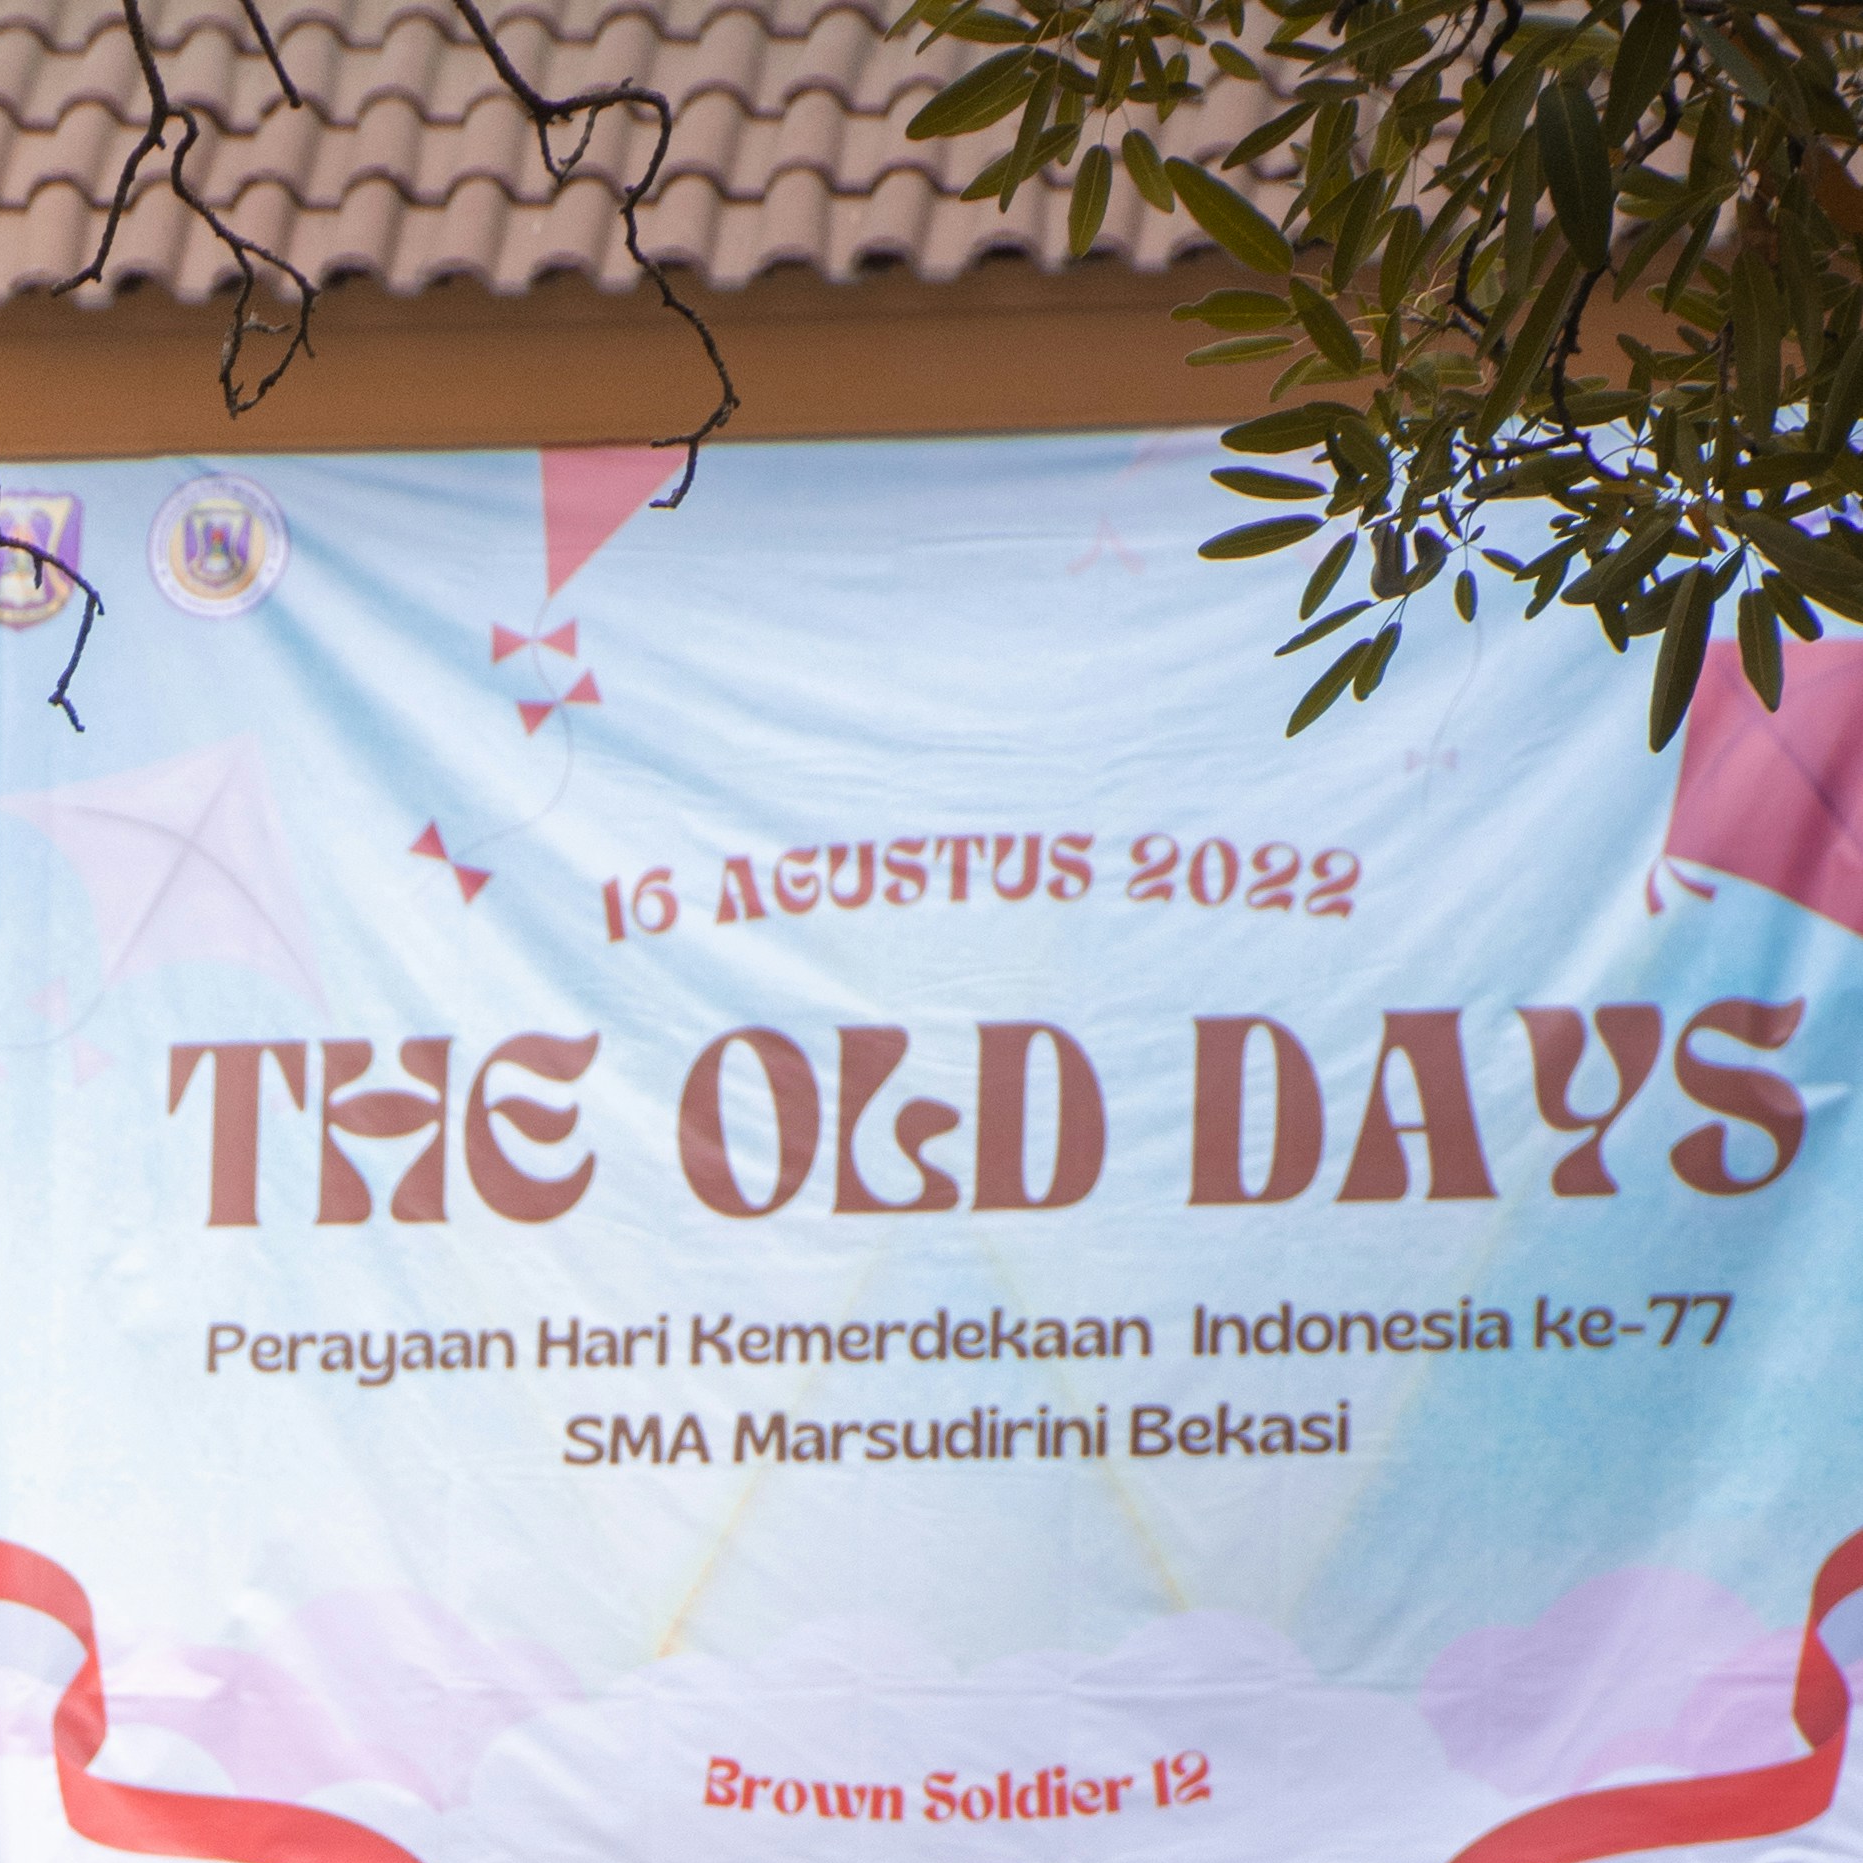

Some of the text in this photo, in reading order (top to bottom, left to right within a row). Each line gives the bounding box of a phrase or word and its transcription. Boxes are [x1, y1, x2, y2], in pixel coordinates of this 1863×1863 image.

[601, 832, 1363, 944] 16 AGUSTUS 2022
[167, 996, 1809, 1228] THE OLD DAYS
[204, 1290, 1736, 1389] Perayaan Hari Kemerdekaan Indonesia ke-77
[562, 1398, 1351, 1467] SMA Marsudirini Bekasi
[703, 1750, 1213, 1823] Brown Soldier 12
